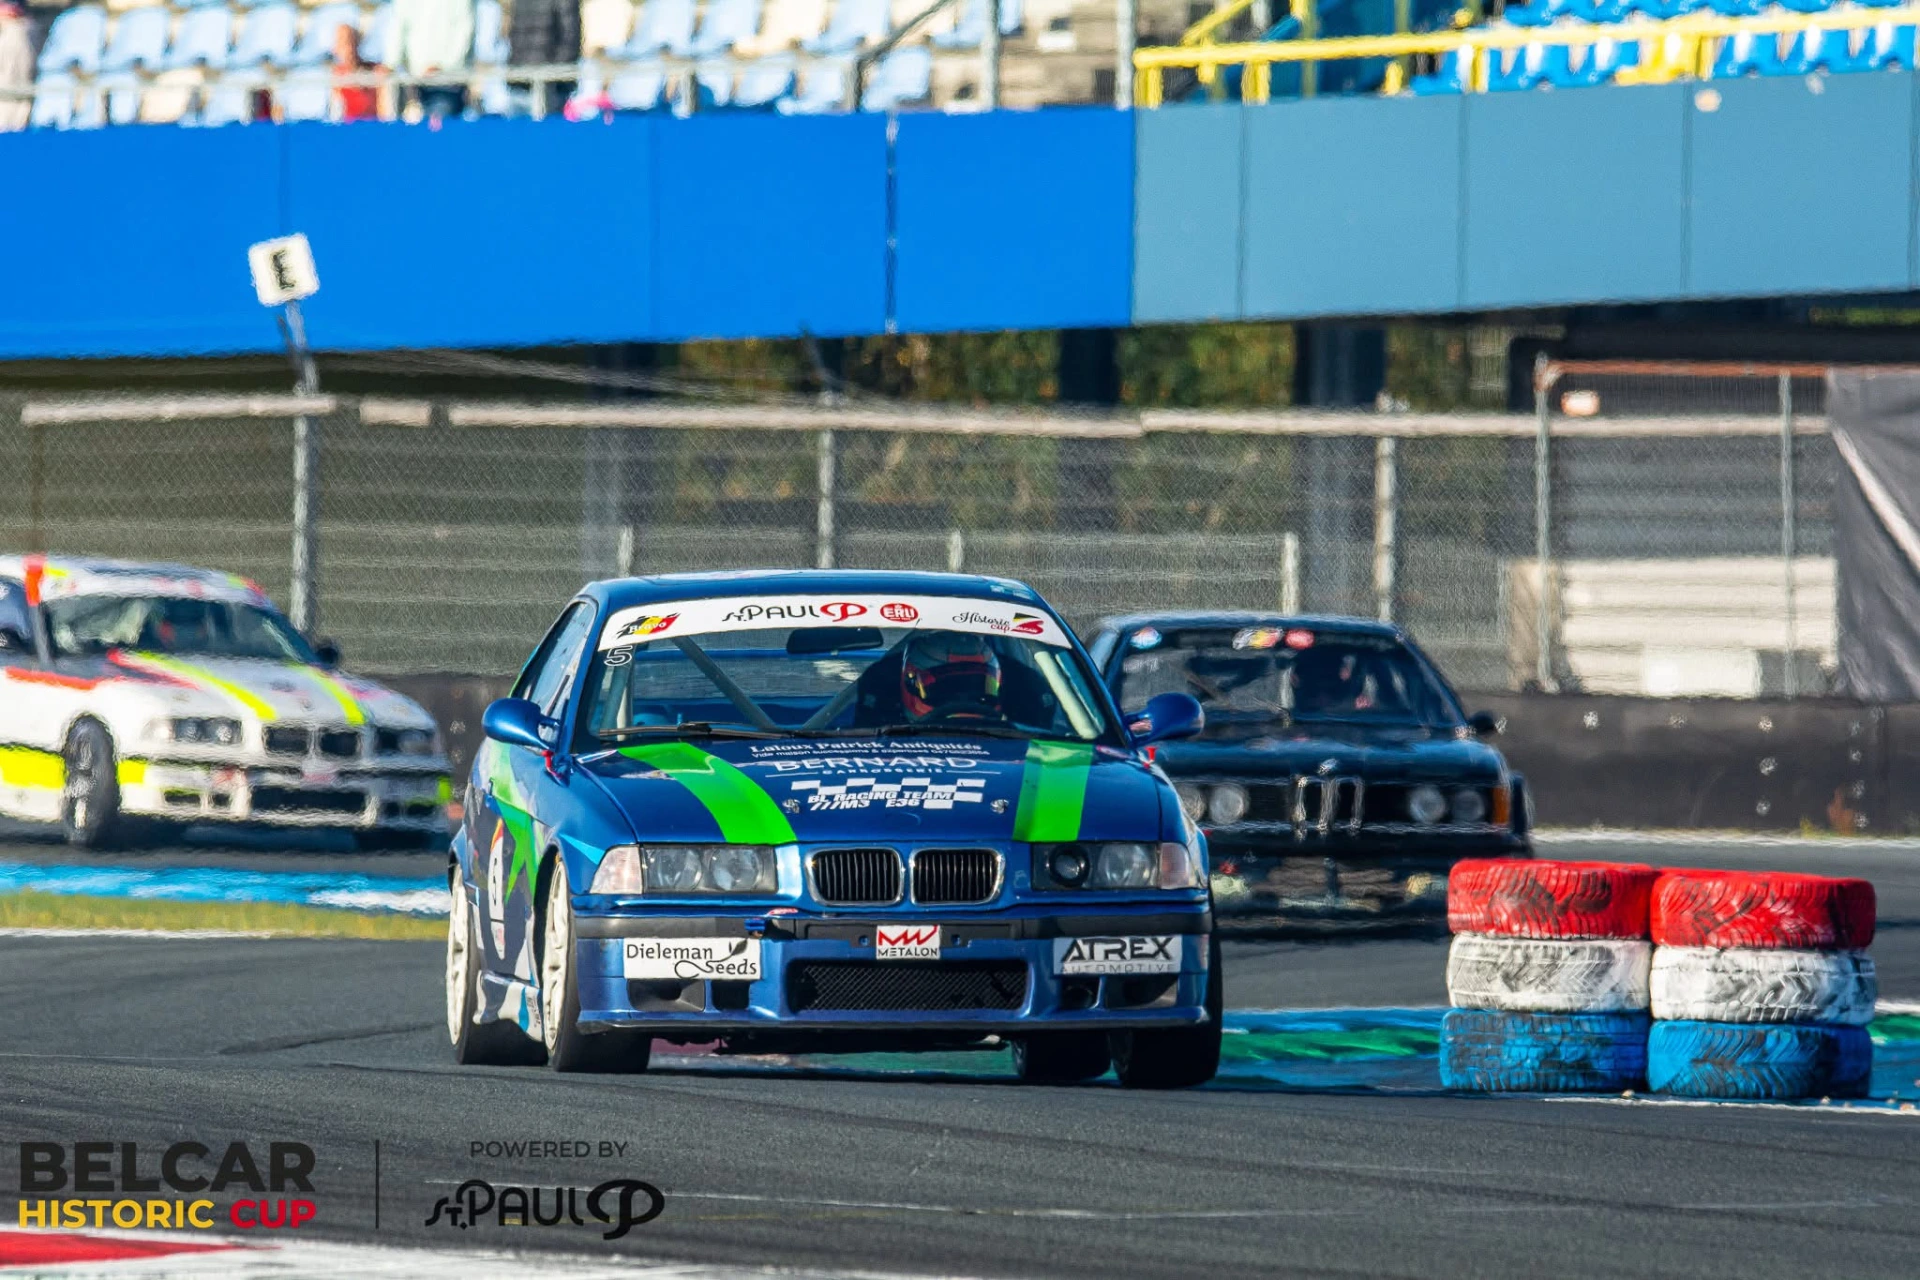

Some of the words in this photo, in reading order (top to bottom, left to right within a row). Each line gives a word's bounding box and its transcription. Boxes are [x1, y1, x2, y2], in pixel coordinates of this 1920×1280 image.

[271, 247, 297, 290] E
[882, 606, 915, 618] ERU
[952, 612, 1010, 625] Historic
[627, 622, 667, 636] Bravo
[604, 645, 634, 667] 5
[750, 744, 813, 753] Laloux
[816, 741, 884, 750] Patrick
[890, 741, 982, 750] Antiquités
[774, 756, 977, 772] BERNARD
[808, 794, 829, 804] BL
[833, 791, 898, 801] RACING
[903, 791, 953, 800] TEAM
[886, 798, 921, 808] E36
[626, 943, 713, 960] Dieleman
[877, 947, 938, 957] METALON
[1061, 937, 1175, 961] ATREX
[705, 959, 757, 975] Seeds
[1062, 964, 1176, 974] AUTOMOTIVE
